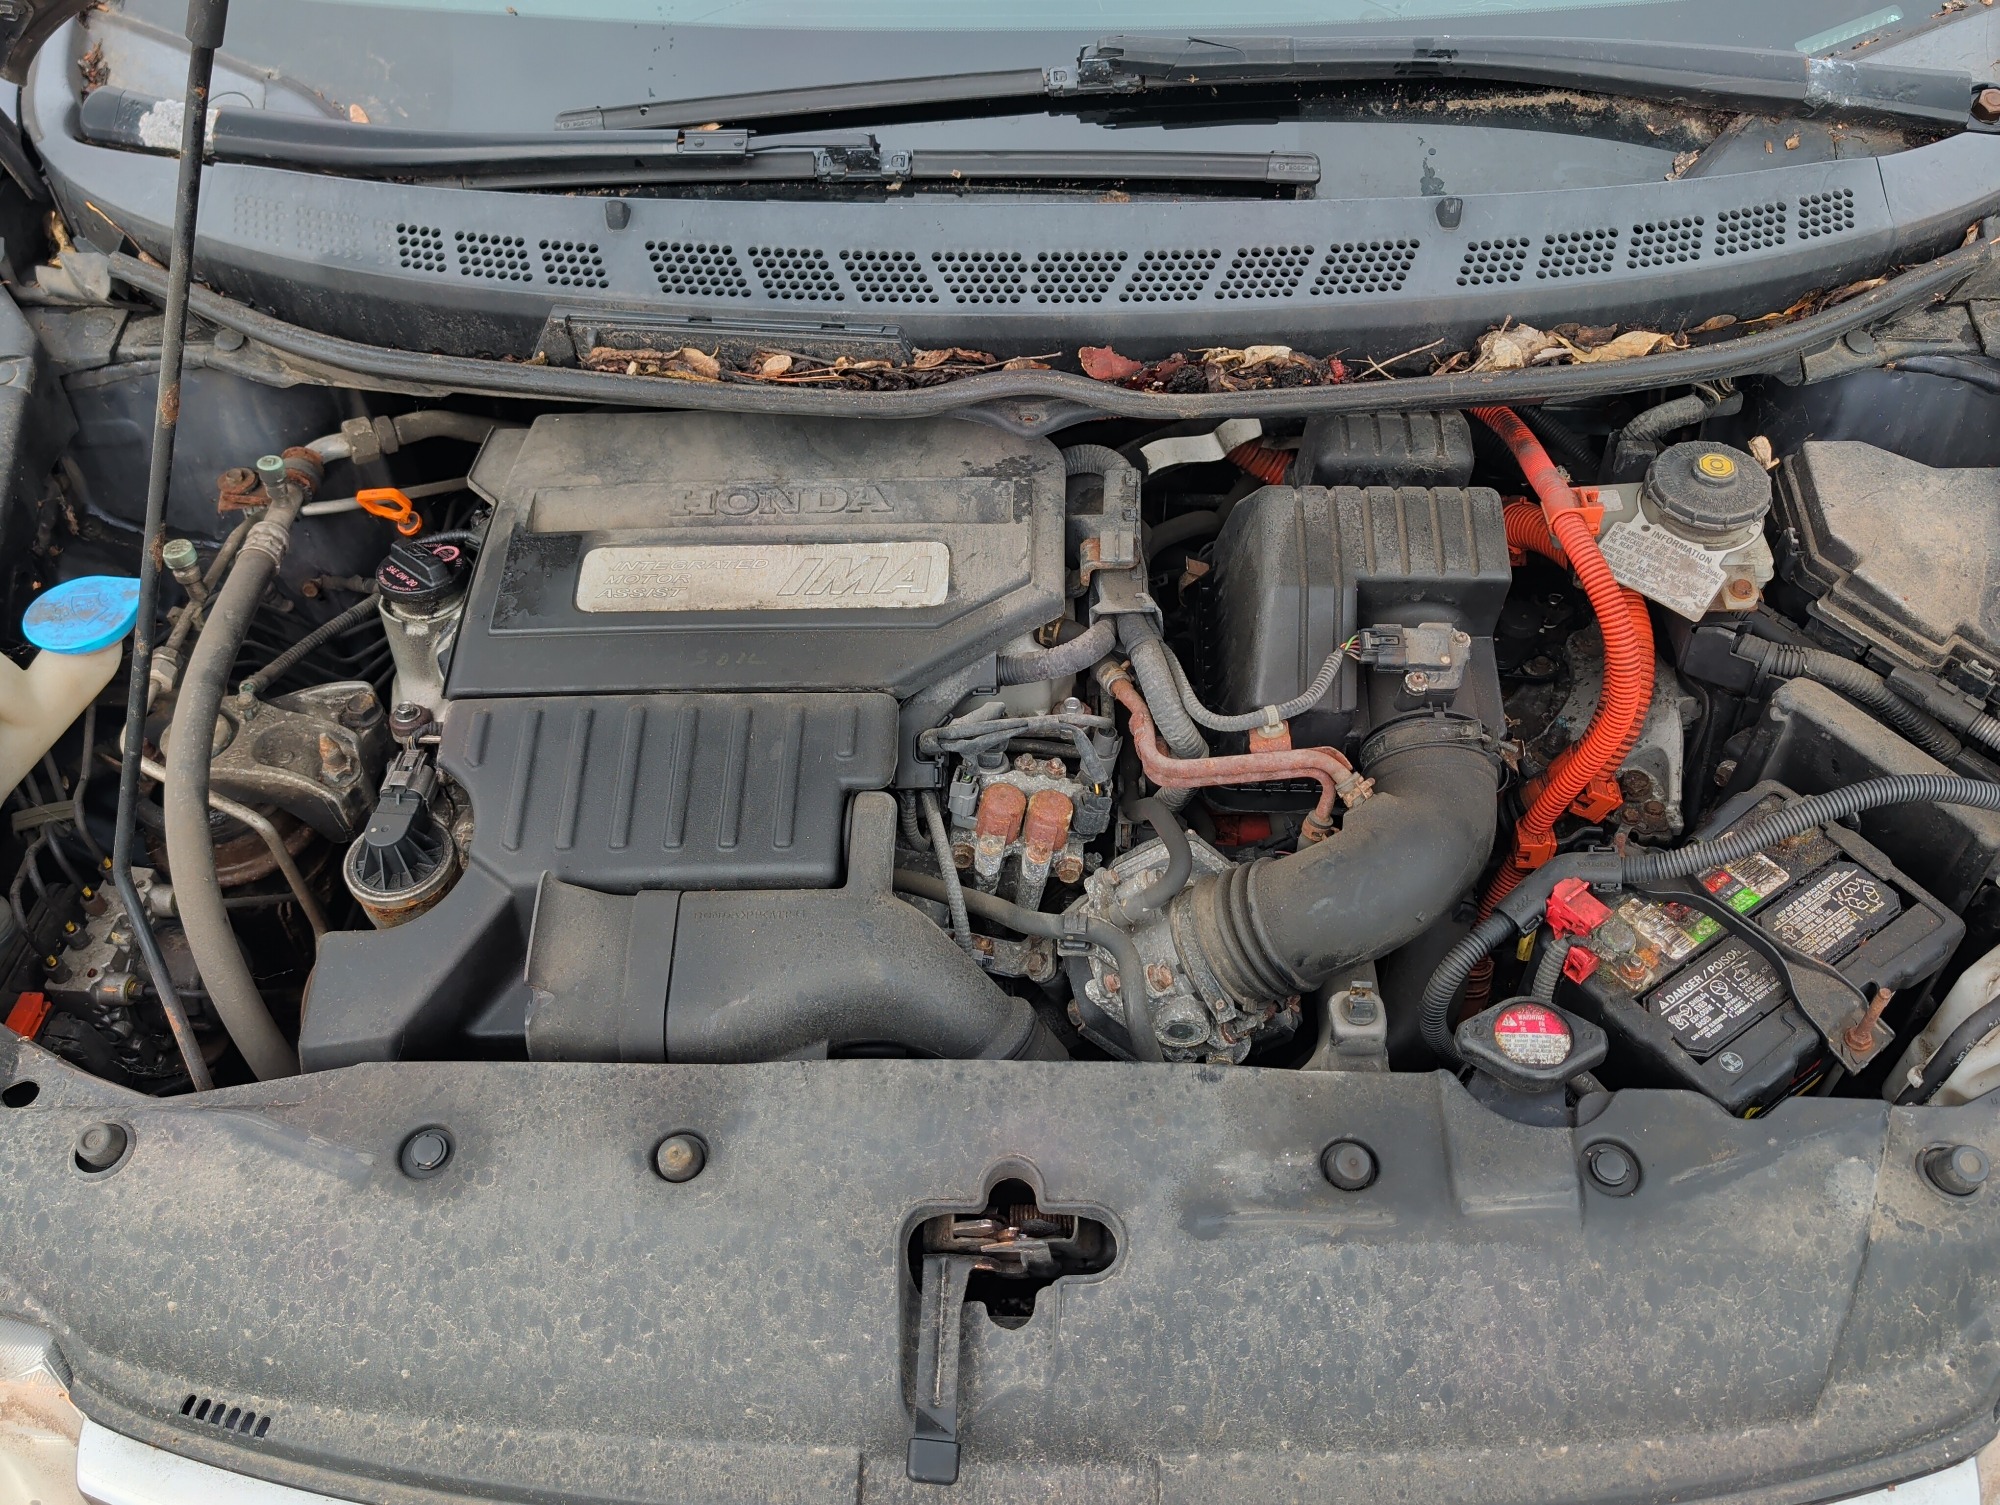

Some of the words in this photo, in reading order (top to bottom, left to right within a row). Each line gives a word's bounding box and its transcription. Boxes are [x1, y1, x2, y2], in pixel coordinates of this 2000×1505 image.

[670, 484, 894, 517] HONDA
[1652, 530, 1713, 564] INFORMATION
[386, 565, 399, 575] SAE
[611, 559, 769, 571] INTEGRATED
[603, 574, 692, 585] MOTOR
[776, 555, 932, 596] IMA
[595, 587, 688, 598] ASSIST
[1665, 975, 1703, 1003] DANGER
[1701, 970, 1709, 978] /
[1707, 947, 1742, 973] POISON
[1689, 992, 1706, 1006] SHIELD
[1723, 992, 1732, 1000] NO
[1694, 1000, 1707, 1011] EYES
[1695, 1015, 1711, 1028] GASES
